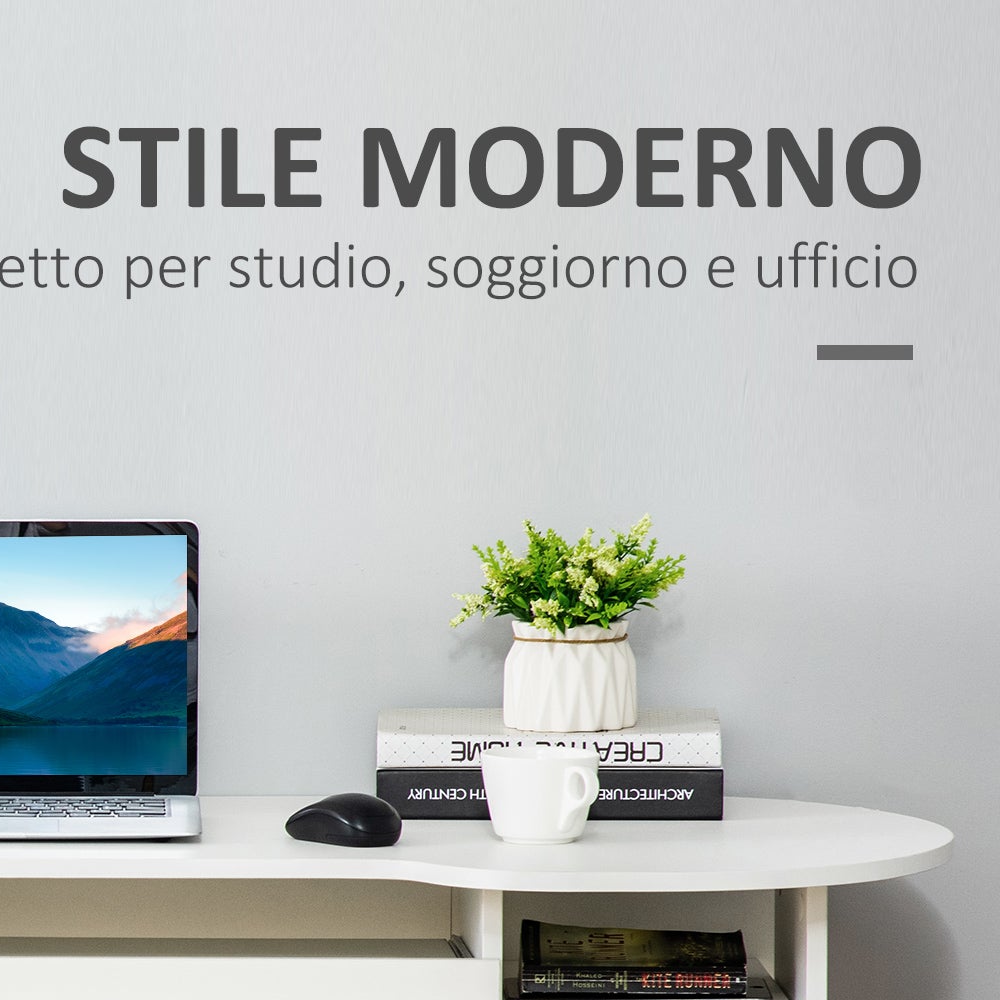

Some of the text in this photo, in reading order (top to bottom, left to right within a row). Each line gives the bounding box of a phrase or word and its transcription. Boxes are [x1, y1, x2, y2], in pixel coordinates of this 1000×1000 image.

[408, 788, 467, 801] CENTURY
[599, 788, 694, 801] ARCHITECTURE
[642, 973, 672, 988] KITE
[675, 973, 731, 989] RUNNER
